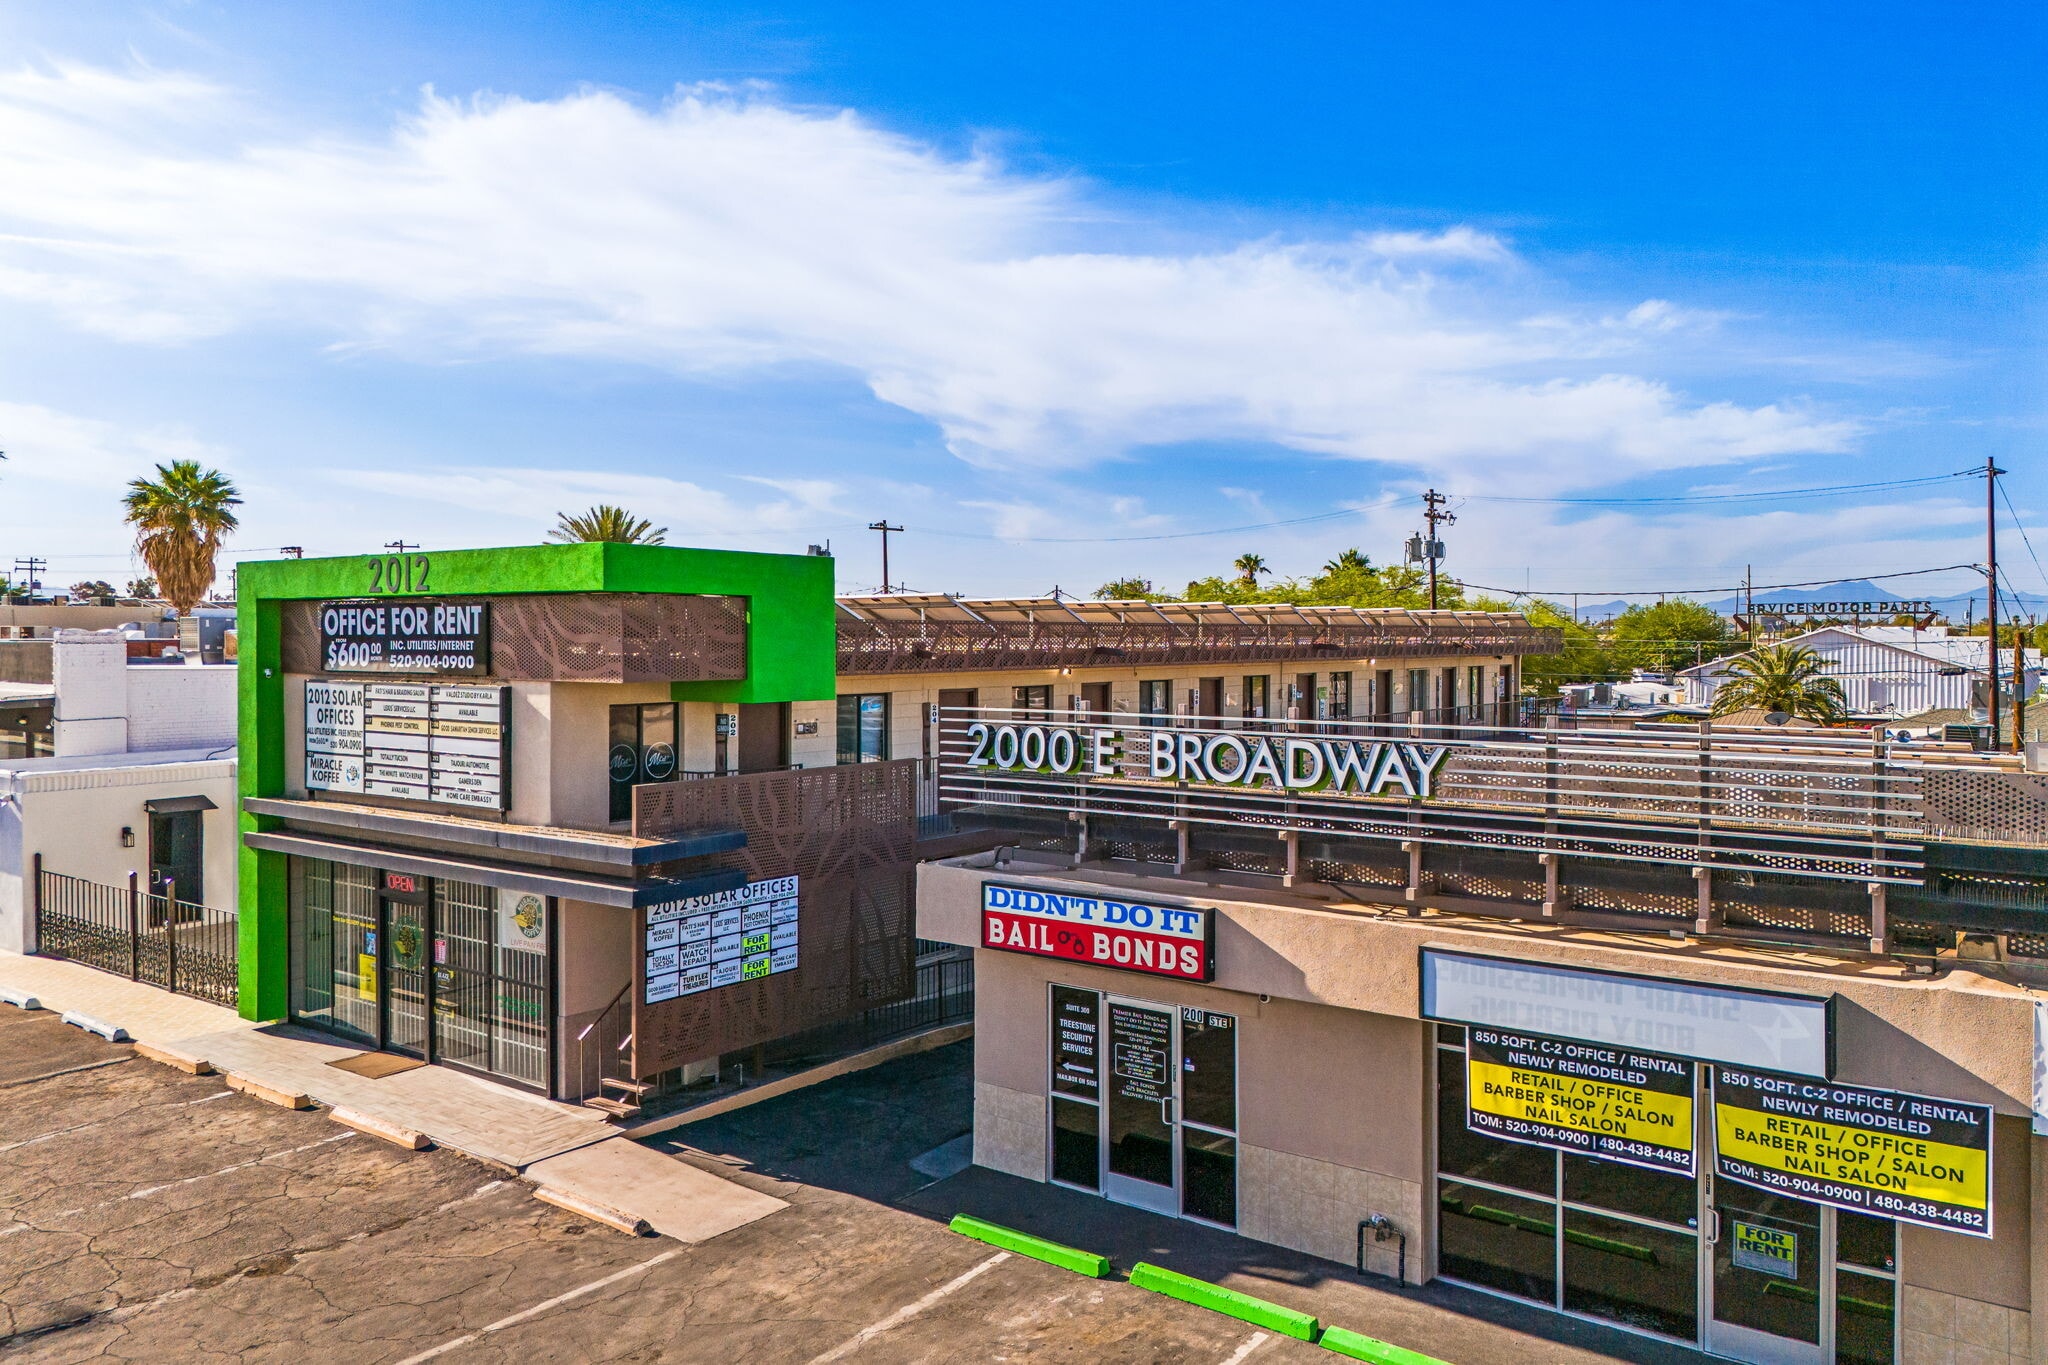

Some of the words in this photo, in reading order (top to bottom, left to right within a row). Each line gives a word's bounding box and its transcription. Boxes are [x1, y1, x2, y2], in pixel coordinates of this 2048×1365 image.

[369, 556, 430, 593] 2012
[1813, 603, 1872, 614] MOTOR
[1879, 602, 1932, 613] PARTS
[324, 608, 386, 636] OFFICE
[391, 607, 429, 636] FOR
[434, 606, 482, 635] RENT
[390, 640, 406, 651] INC.
[406, 640, 474, 651] UTILITIES/INTERNET
[328, 641, 369, 668] $600
[389, 655, 475, 669] 520-904-0900
[308, 688, 331, 705] 2012
[332, 689, 363, 707] SOLAR
[316, 708, 355, 726] OFFICES
[310, 758, 342, 771] MIRACLE
[967, 723, 1077, 774] 2000
[1093, 730, 1116, 775] E
[1152, 731, 1447, 797] BROADWAY
[312, 770, 340, 783] KOFFEE
[446, 792, 458, 800] HOME
[472, 795, 492, 803] EMBASSY
[388, 874, 415, 893] OPEN
[652, 899, 688, 916] 2012
[692, 889, 738, 908] SOLAR
[742, 878, 794, 898] OFFICES
[744, 910, 769, 922] PHOENIX
[988, 887, 1098, 920] DIDN'T
[1104, 901, 1153, 928] DO
[1160, 908, 1199, 934] IT
[652, 927, 675, 936] MIRACLE
[654, 933, 673, 942] KOFFEE
[773, 931, 797, 941] AVAILABLE
[747, 935, 765, 945] FOR
[988, 917, 1054, 952] BAIL
[1093, 932, 1199, 974] BONDS
[682, 947, 709, 959] WATCH
[713, 943, 739, 954] AVAILABLE
[744, 943, 767, 954] RENT
[652, 953, 675, 963] TOTALLY
[652, 960, 674, 968] TUCSON
[683, 956, 707, 966] REPAIR
[747, 960, 765, 970] FOR
[774, 959, 795, 968] EMBASSY
[716, 965, 739, 974] TAJOURI
[744, 967, 767, 980] RENT
[683, 972, 708, 983] TURTLEZ
[683, 980, 709, 991] TREASURES
[1065, 1004, 1080, 1013] SUITE
[1184, 1008, 1203, 1023] 200
[1059, 1018, 1096, 1033] TREESTONE
[1210, 1016, 1228, 1028] STE
[1062, 1031, 1093, 1044] SECURITY
[1062, 1042, 1093, 1056] SERVICES
[1132, 1044, 1150, 1052] HOURS
[1475, 1031, 1498, 1045] 850
[1501, 1035, 1537, 1051] SQFT.
[1541, 1041, 1562, 1055] C-2
[1565, 1045, 1615, 1064] OFFICE
[1619, 1053, 1626, 1065] /
[1630, 1055, 1686, 1075] RENTAL
[1508, 1052, 1555, 1069] NEWLY
[1558, 1060, 1647, 1085] REMODELED
[1056, 1073, 1078, 1083] MAILBOX
[1086, 1079, 1098, 1087] SIDE
[1511, 1071, 1564, 1092] RETAIL
[1570, 1081, 1577, 1093] /
[1582, 1084, 1643, 1105] OFFICE
[1484, 1082, 1545, 1104] BARBER
[1551, 1094, 1596, 1113] SHOP
[1602, 1102, 1609, 1115] /
[1615, 1105, 1674, 1127] SALON
[1722, 1072, 1749, 1087] 850
[1753, 1077, 1797, 1096] SQFT.
[1802, 1085, 1828, 1100] C-2
[1832, 1090, 1893, 1111] OFFICE
[1898, 1100, 1906, 1113] /
[1910, 1103, 1979, 1126] RENTAL
[1525, 1105, 1563, 1123] NAIL
[1569, 1113, 1627, 1135] SALON
[1762, 1096, 1819, 1116] NEWLY
[1823, 1107, 1931, 1135] REMODELED
[1473, 1112, 1503, 1129] TOM:
[1505, 1118, 1589, 1146] 520-904-0900
[1600, 1137, 1690, 1166] 480-438-4482
[1767, 1118, 1831, 1141] RETAIL
[1837, 1130, 1846, 1144] /
[1853, 1133, 1927, 1158] OFFICE
[1735, 1128, 1808, 1154] BARBER
[1815, 1143, 1870, 1165] SHOP
[1877, 1154, 1885, 1168] /
[1893, 1158, 1964, 1183] SALON
[1784, 1155, 1830, 1176] NAIL
[1837, 1166, 1907, 1191] SALON
[1722, 1159, 1759, 1180] TOM:
[1762, 1172, 1861, 1202] 520-904-0900
[1874, 1195, 1984, 1227] 480-438-4482
[1745, 1226, 1785, 1246] FOR
[1739, 1240, 1793, 1260] RENT
